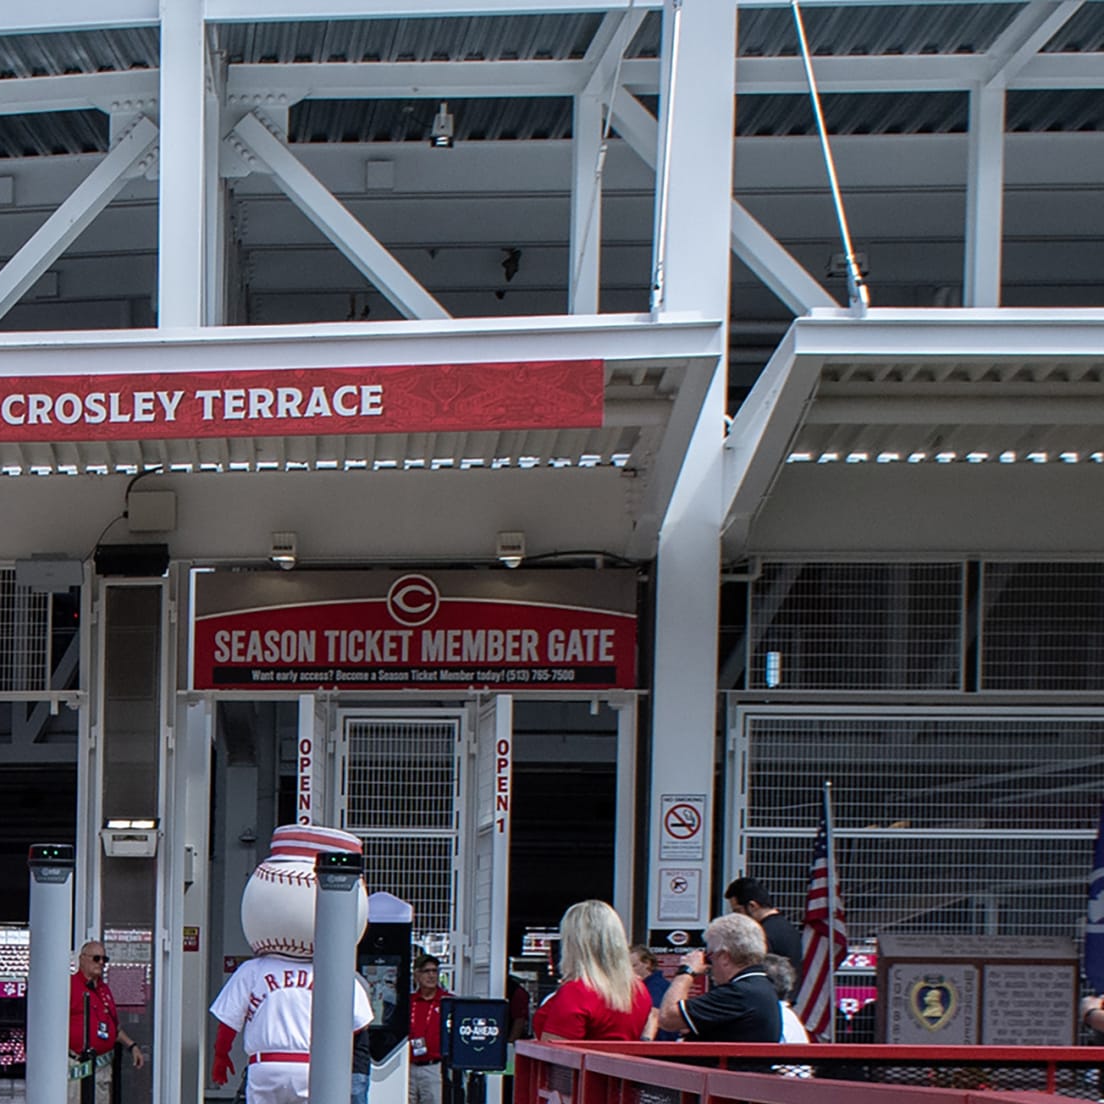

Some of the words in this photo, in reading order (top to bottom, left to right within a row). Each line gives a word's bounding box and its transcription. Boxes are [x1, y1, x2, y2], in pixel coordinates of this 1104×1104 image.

[1, 390, 185, 425] CROSLEY
[194, 384, 384, 420] TERRACE
[214, 630, 316, 663] SEASON
[324, 630, 413, 663] TICKET
[421, 629, 538, 662] MEMBER
[547, 629, 615, 662] GATE
[251, 670, 274, 681] Want
[276, 670, 297, 682] early
[300, 670, 333, 681] access?
[336, 670, 368, 681] Become
[370, 672, 376, 681] a
[378, 670, 409, 681] Season
[411, 670, 437, 681] Ticket
[440, 670, 474, 681] Member
[476, 670, 505, 682] today!
[506, 670, 530, 682] (513)
[299, 739, 312, 810] OPEN
[496, 739, 509, 811] OPEN
[496, 818, 505, 833] 1
[459, 1025, 499, 1036] GO-AHEAD
